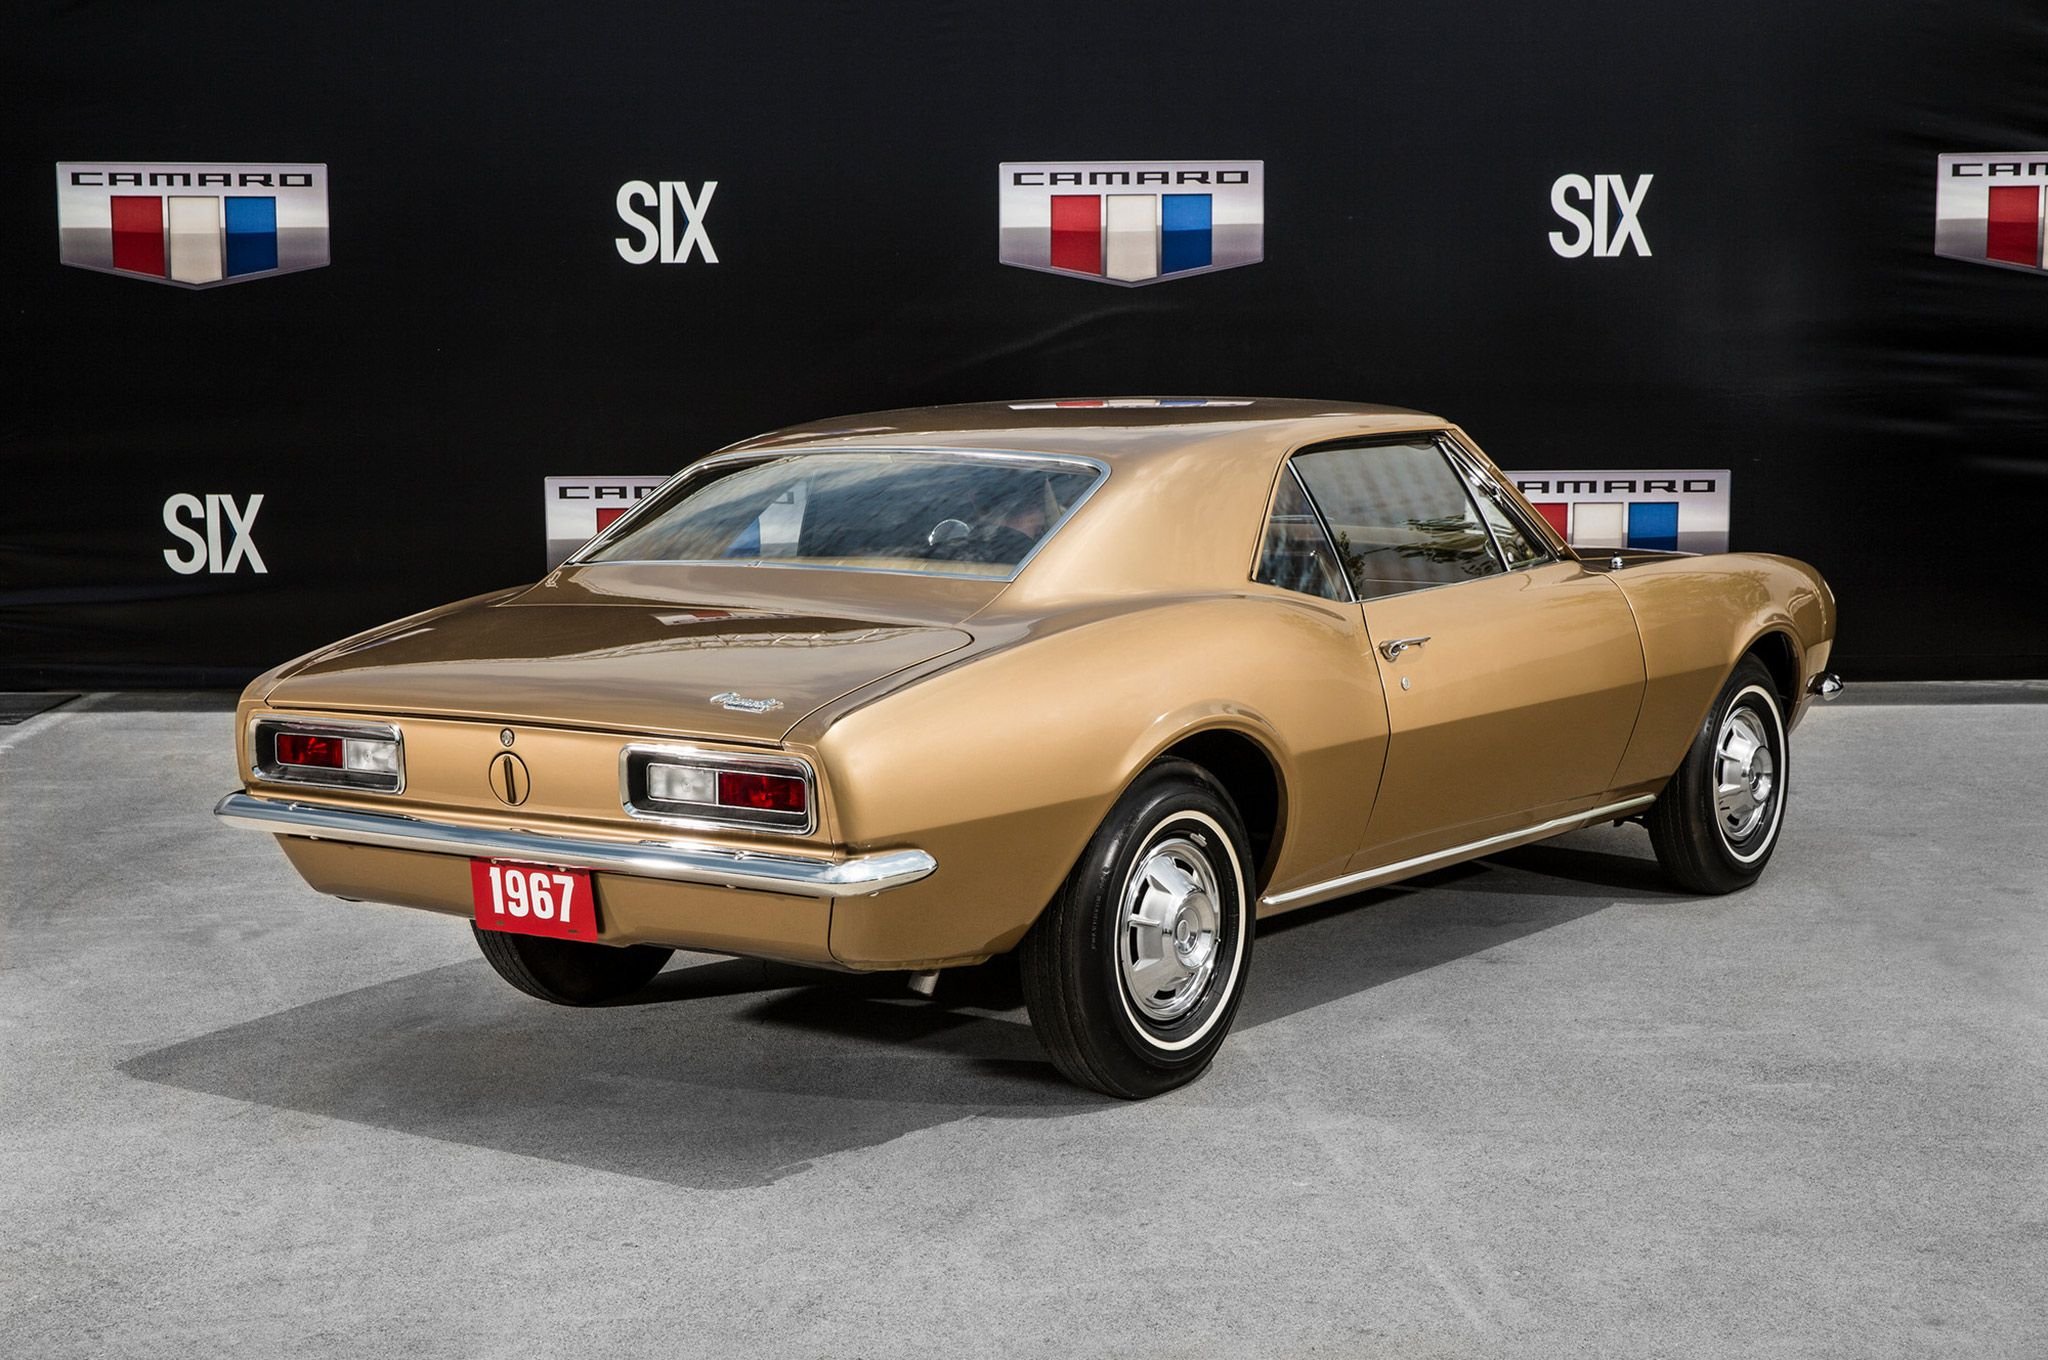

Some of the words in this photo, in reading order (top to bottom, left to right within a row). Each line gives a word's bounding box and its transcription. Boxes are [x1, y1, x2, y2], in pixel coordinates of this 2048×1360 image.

[71, 172, 313, 188] CAMARO
[1013, 170, 1249, 186] CAMARO
[615, 180, 720, 265] SIX
[1548, 173, 1654, 259] SIX
[162, 493, 268, 575] SIX
[489, 866, 575, 923] 1967
